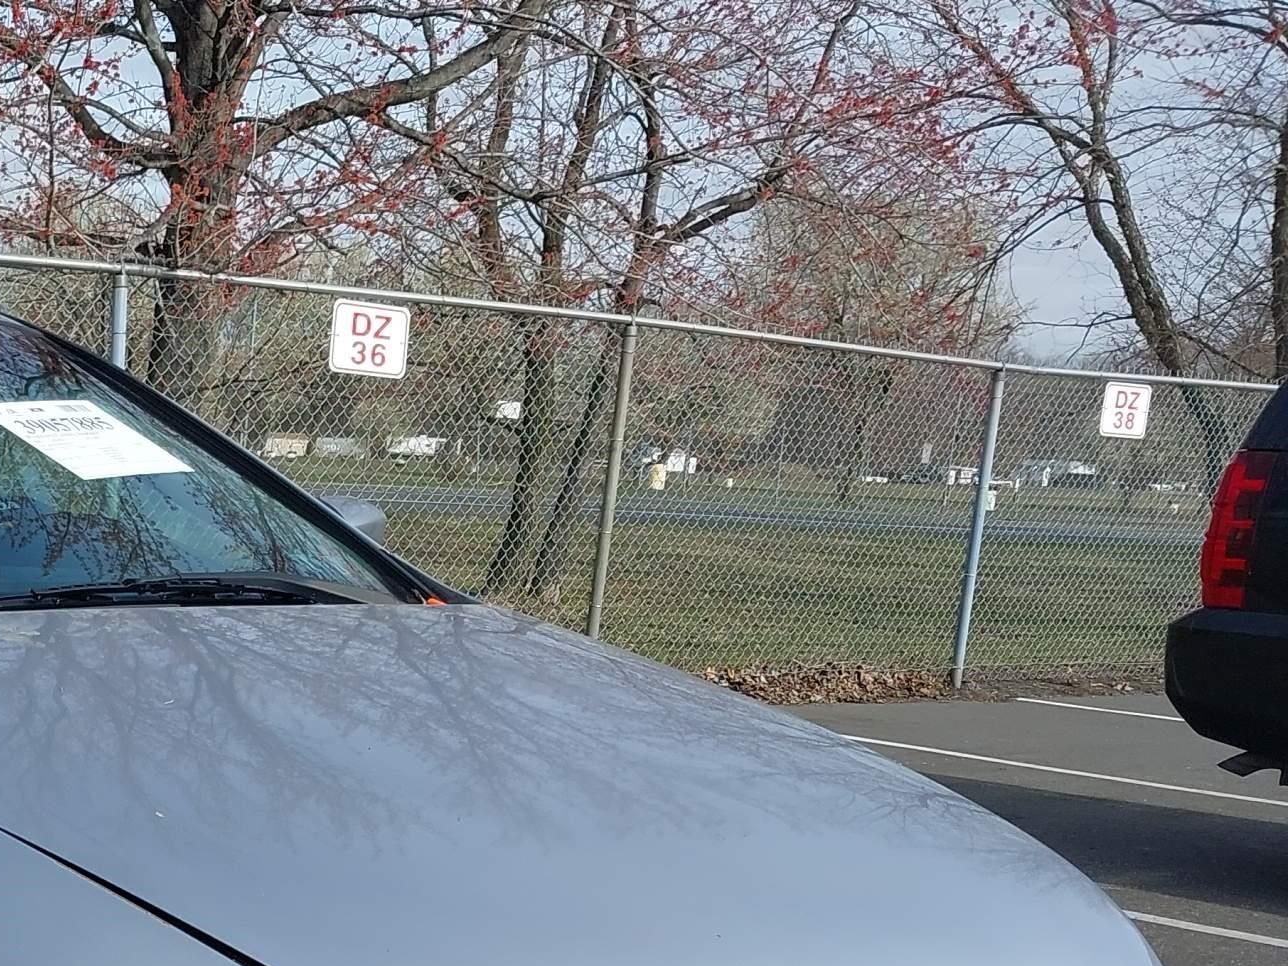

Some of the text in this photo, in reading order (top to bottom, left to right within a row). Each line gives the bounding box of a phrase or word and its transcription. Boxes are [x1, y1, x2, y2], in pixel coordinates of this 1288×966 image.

[351, 312, 392, 340] DZ
[351, 341, 386, 367] 36
[1115, 391, 1142, 410] DZ
[14, 416, 114, 434] 39057885
[1113, 411, 1135, 430] 38
